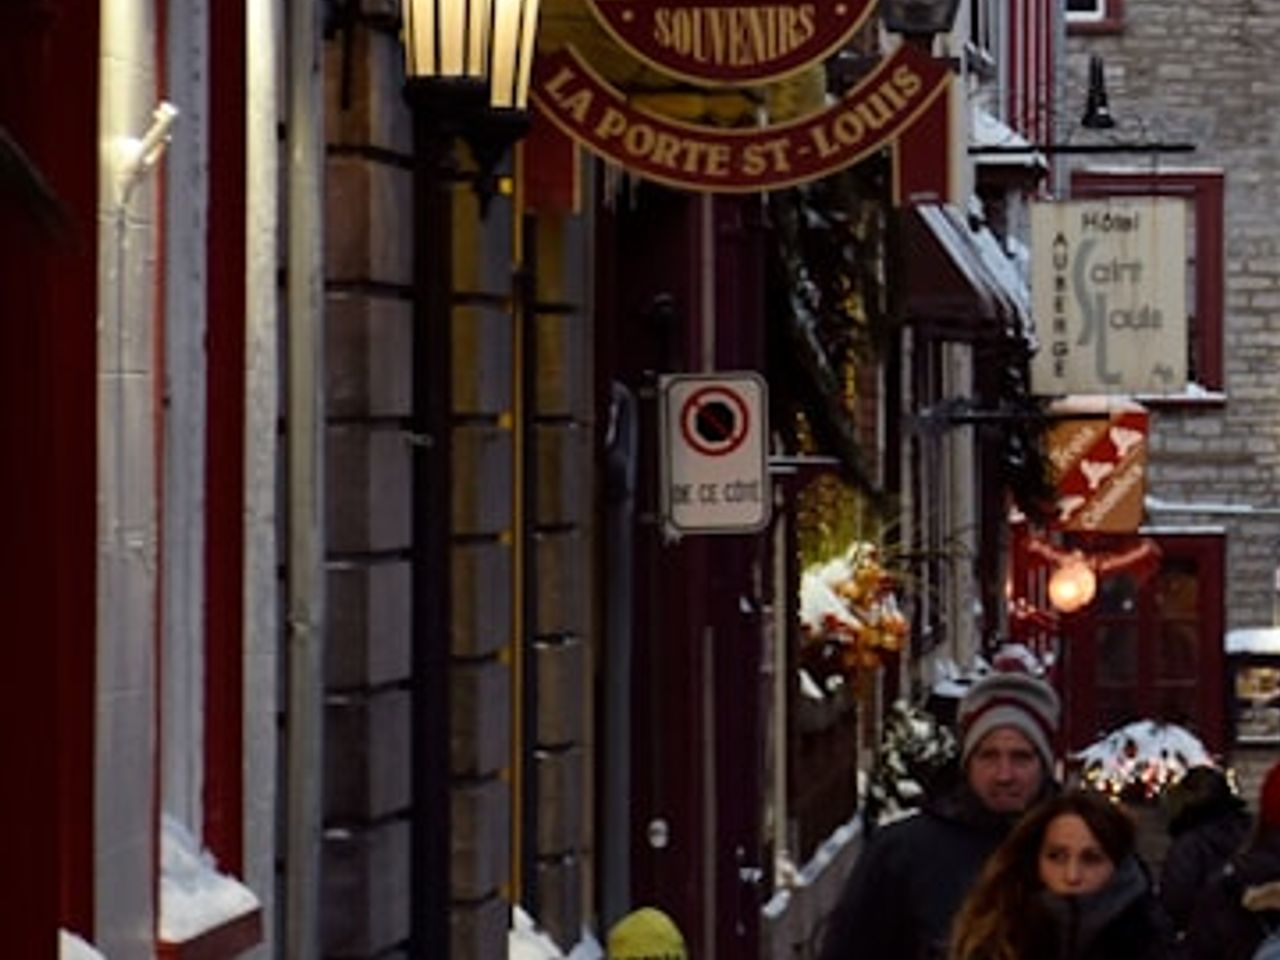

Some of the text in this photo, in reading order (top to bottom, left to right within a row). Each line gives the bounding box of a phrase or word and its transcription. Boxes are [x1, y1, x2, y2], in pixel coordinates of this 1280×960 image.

[653, 3, 816, 67] SOUVENIRS
[545, 67, 588, 123] LA
[596, 109, 730, 176] PORTE
